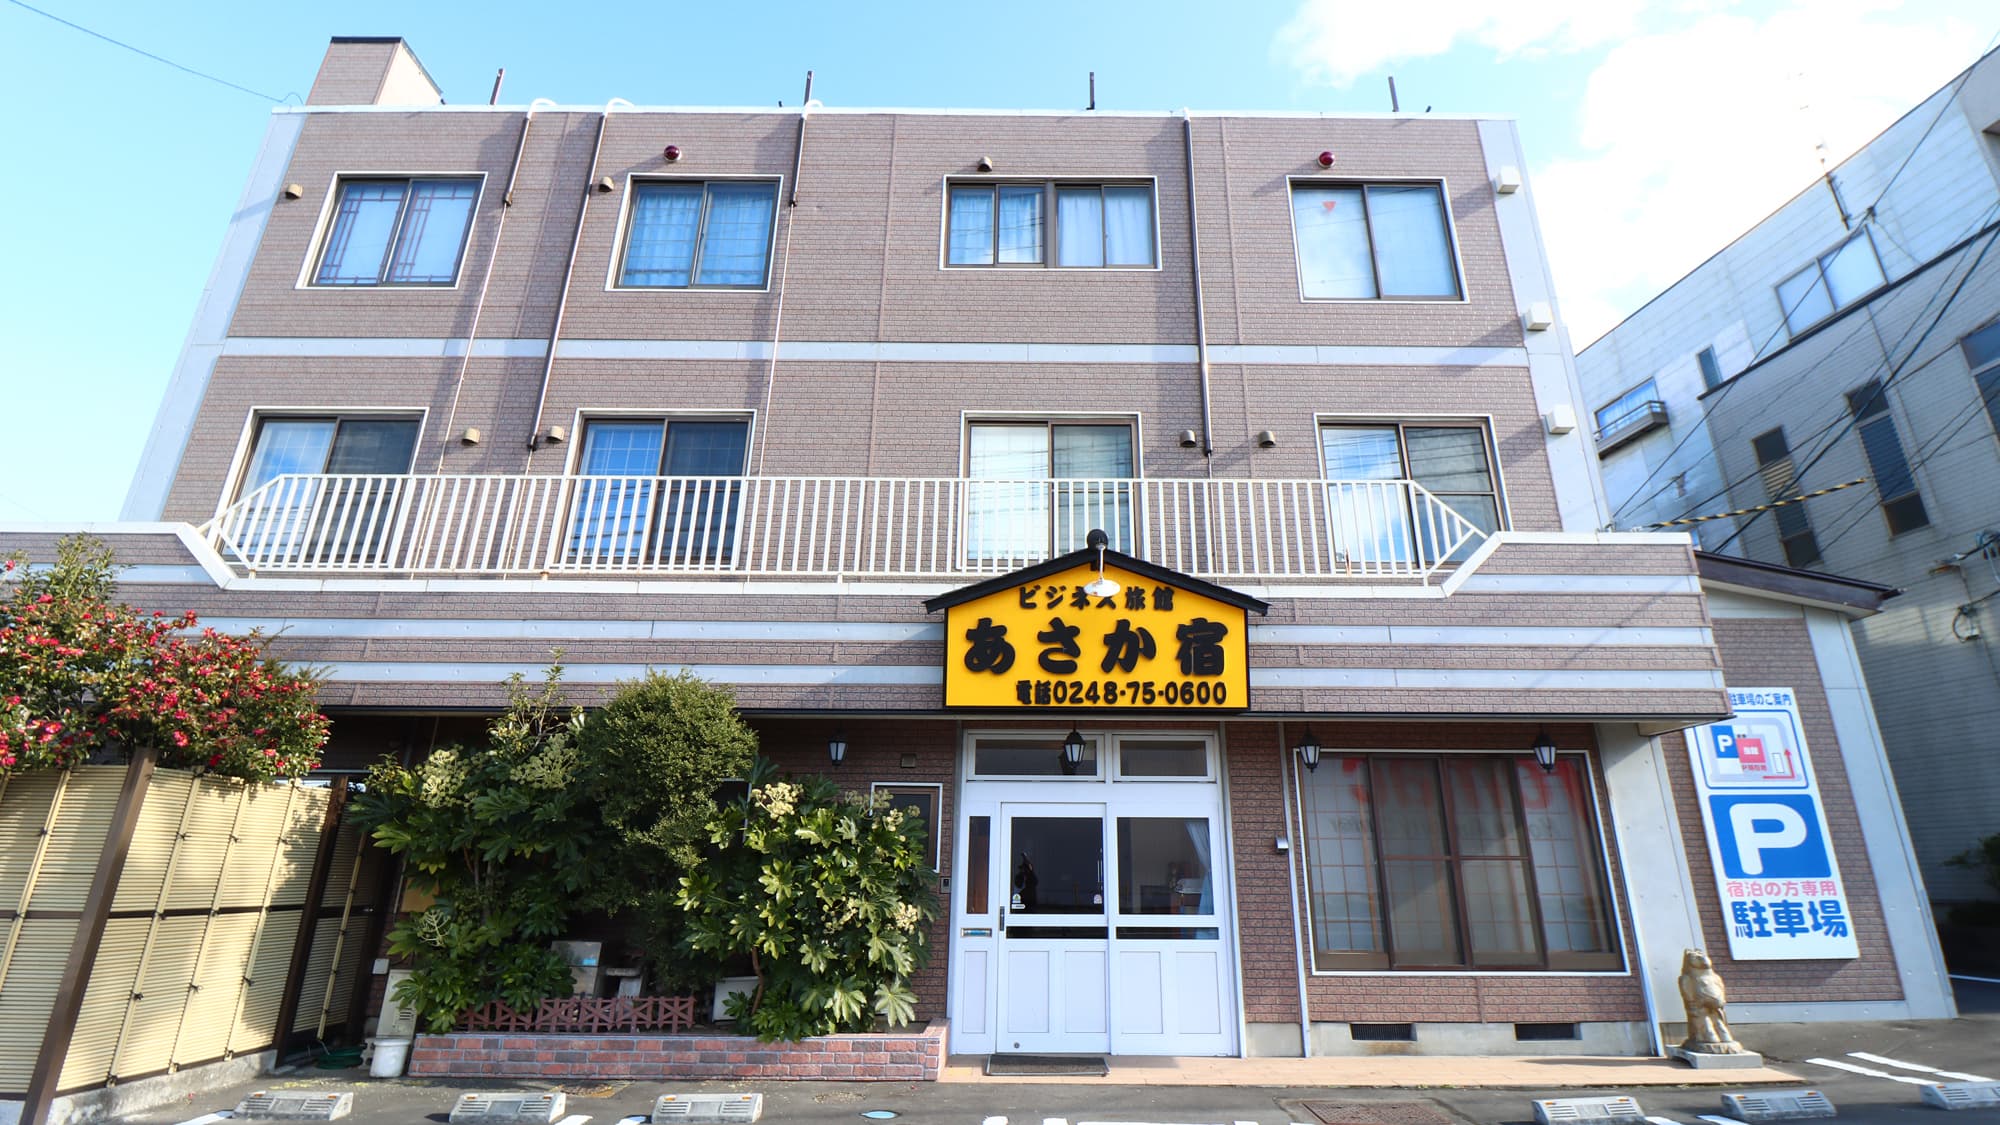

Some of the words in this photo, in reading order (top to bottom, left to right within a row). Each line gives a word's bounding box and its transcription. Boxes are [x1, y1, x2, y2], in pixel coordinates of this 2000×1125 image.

[963, 617, 1229, 676] あさか宿
[1729, 803, 1807, 876] P
[1726, 881, 1838, 898] 宿泊の方専用
[1731, 900, 1848, 939] 駐車場
